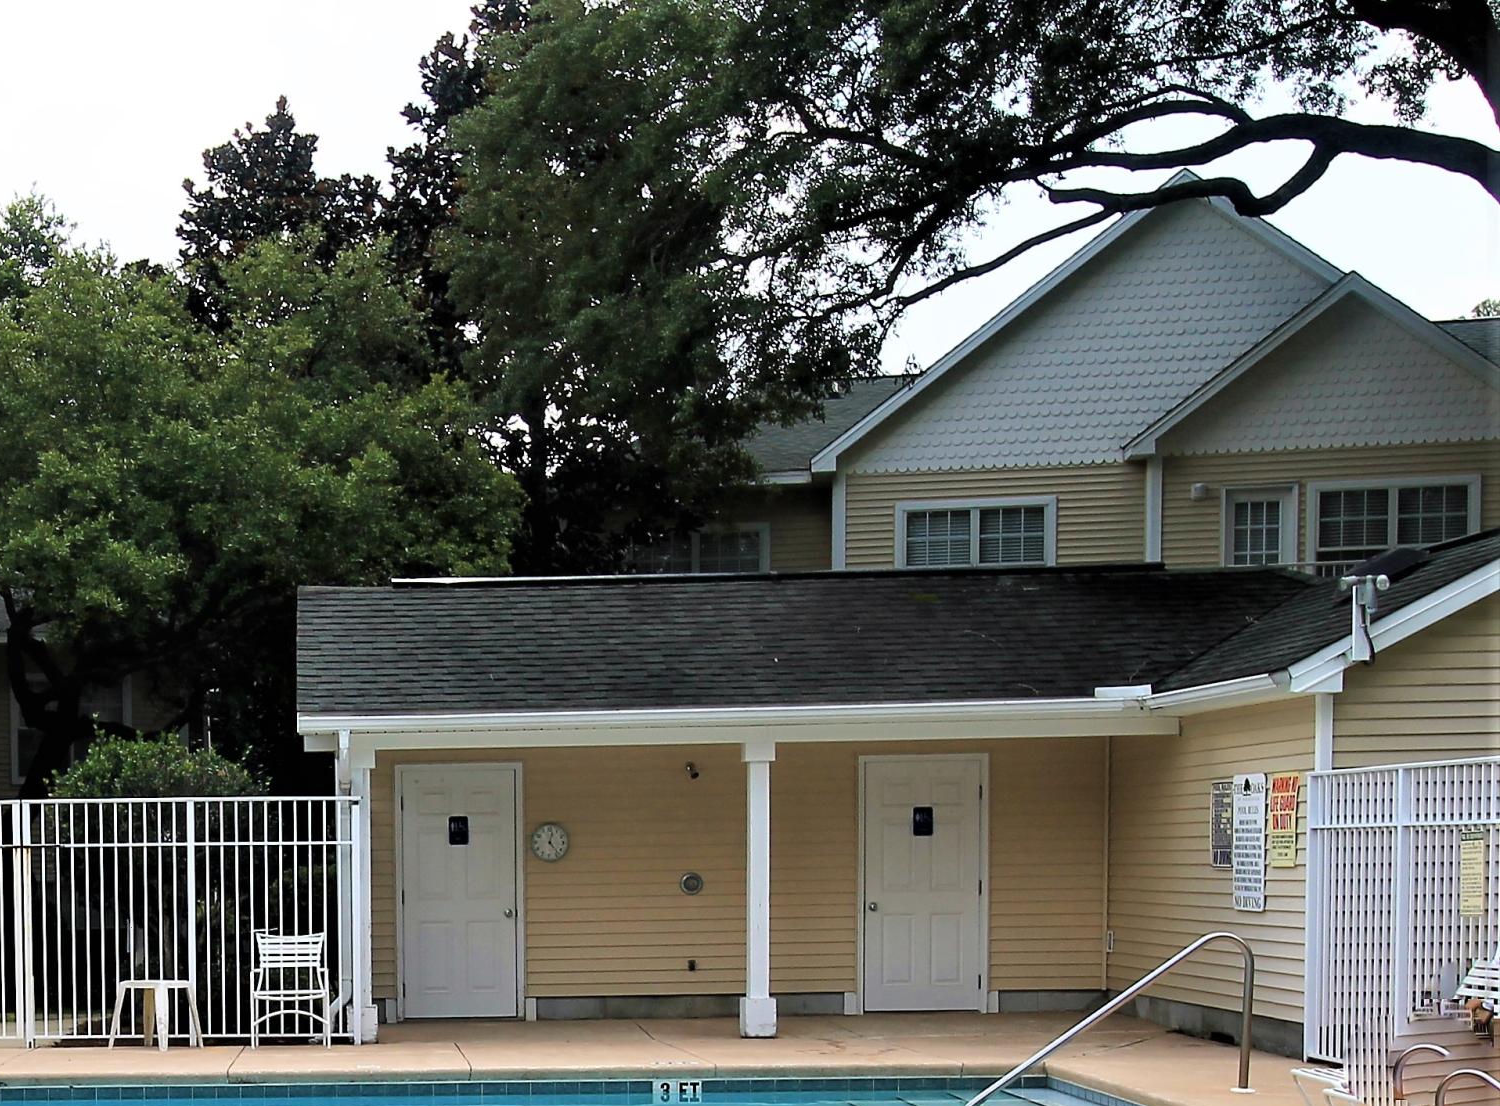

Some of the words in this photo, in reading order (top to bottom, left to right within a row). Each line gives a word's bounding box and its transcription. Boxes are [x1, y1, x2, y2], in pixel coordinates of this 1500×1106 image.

[1234, 896, 1242, 908] NO
[1243, 896, 1262, 909] DIVING
[660, 1082, 671, 1098] 3
